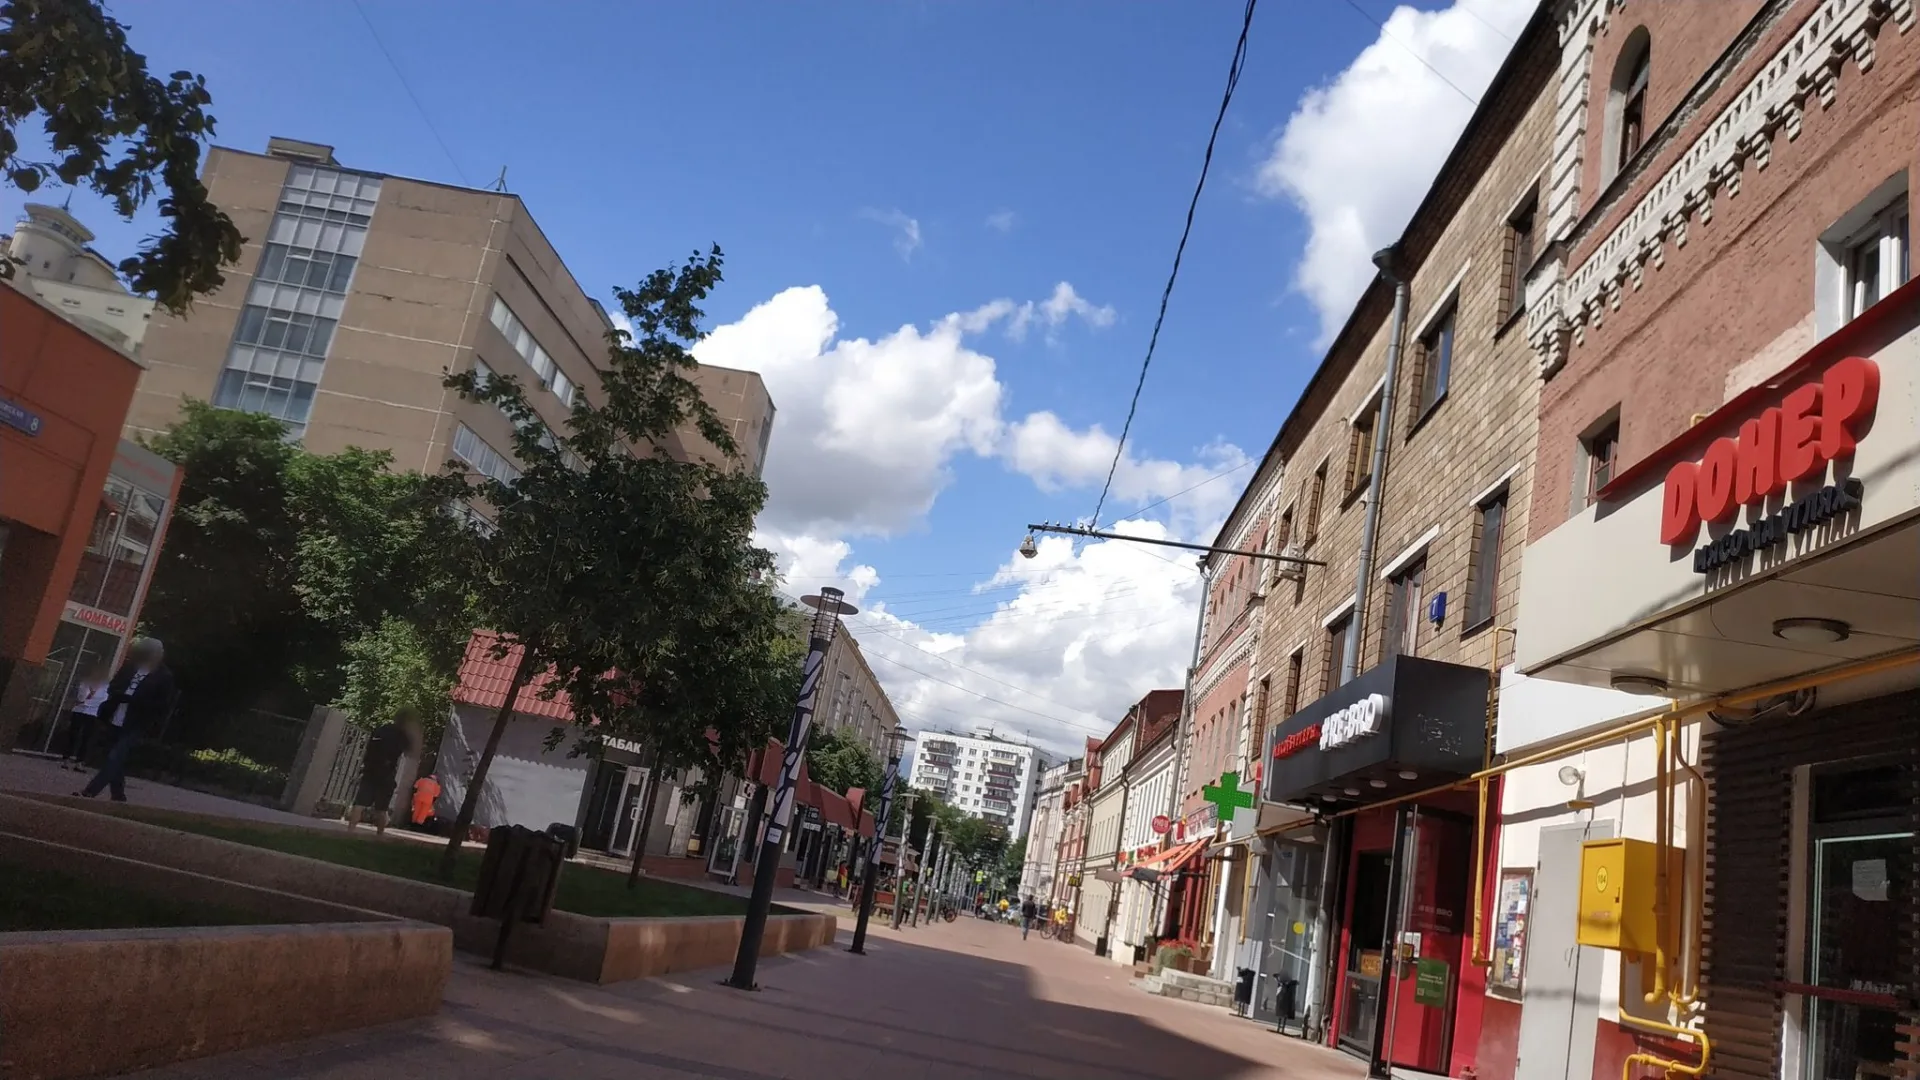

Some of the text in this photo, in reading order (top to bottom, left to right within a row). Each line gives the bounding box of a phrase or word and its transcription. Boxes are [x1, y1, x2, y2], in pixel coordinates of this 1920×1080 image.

[31, 417, 39, 431] 8
[1693, 529, 1750, 574] МЯСО
[1748, 514, 1788, 551] НА
[75, 608, 127, 634] ЛОМБАРД
[601, 734, 642, 754] ТАБАК
